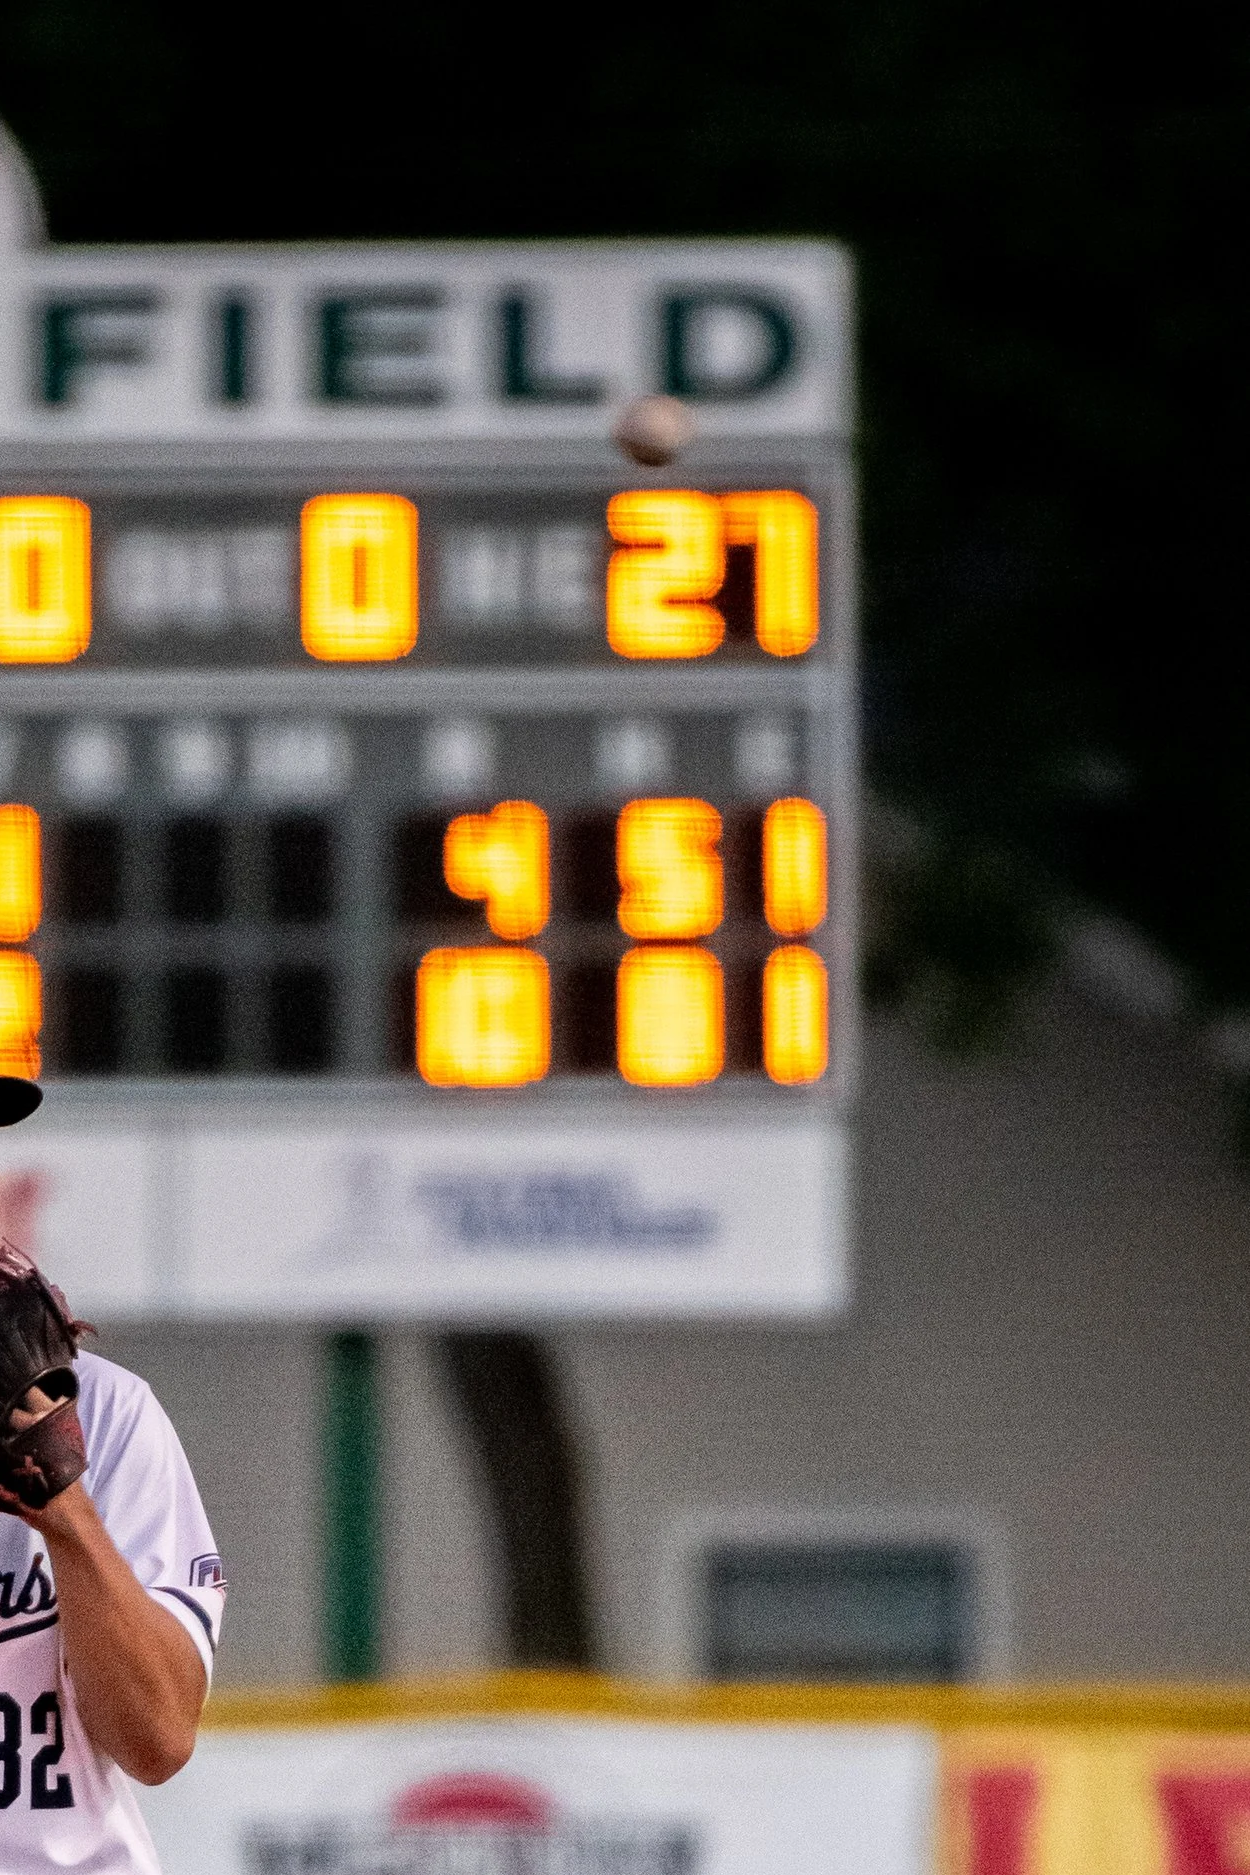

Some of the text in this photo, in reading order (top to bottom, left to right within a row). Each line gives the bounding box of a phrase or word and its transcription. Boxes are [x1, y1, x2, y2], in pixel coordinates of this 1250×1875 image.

[35, 284, 800, 410] FIELD
[301, 493, 418, 661] 0
[606, 490, 818, 658] 27
